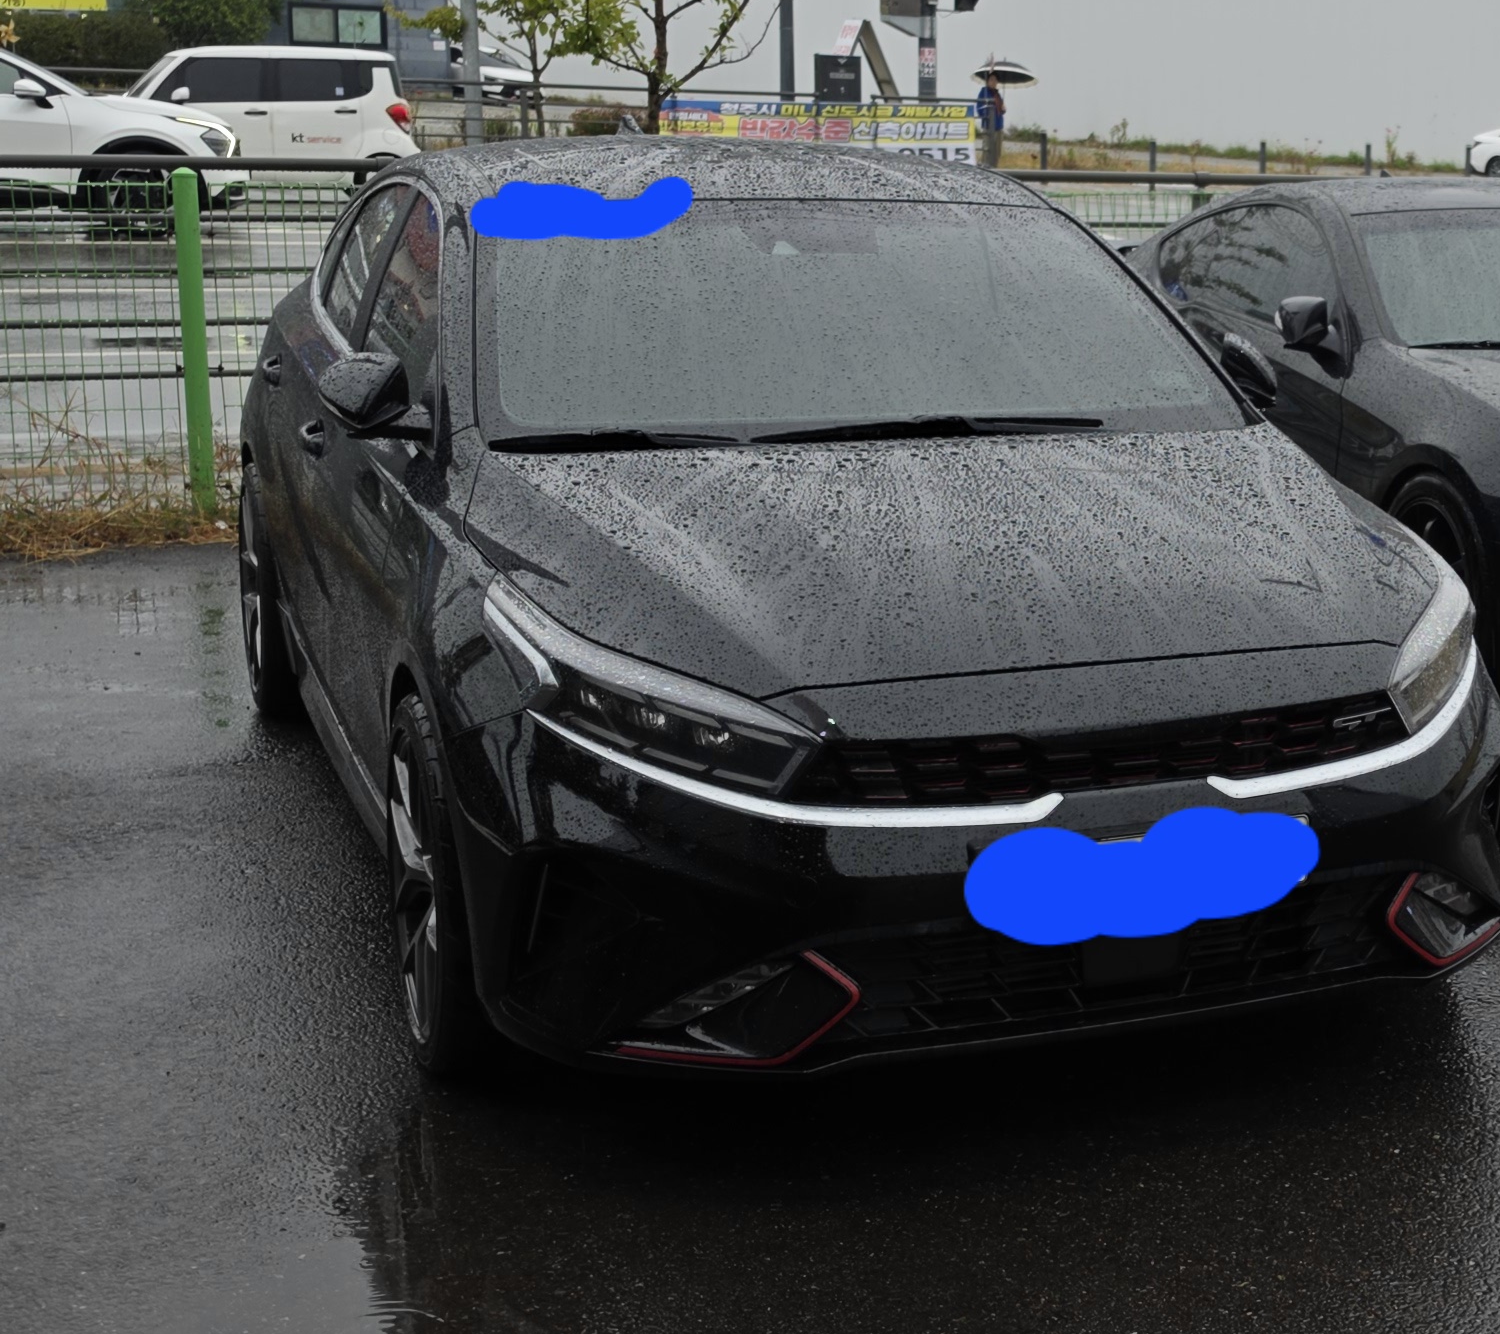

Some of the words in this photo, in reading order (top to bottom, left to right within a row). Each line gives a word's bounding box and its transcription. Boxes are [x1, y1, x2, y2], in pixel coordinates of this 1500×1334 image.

[720, 103, 777, 115] 청주시
[780, 104, 817, 116] 미니
[898, 105, 968, 117] 개발사업
[739, 118, 851, 142] 반값수준
[854, 121, 970, 141] 신축아파트
[291, 133, 304, 143] kt
